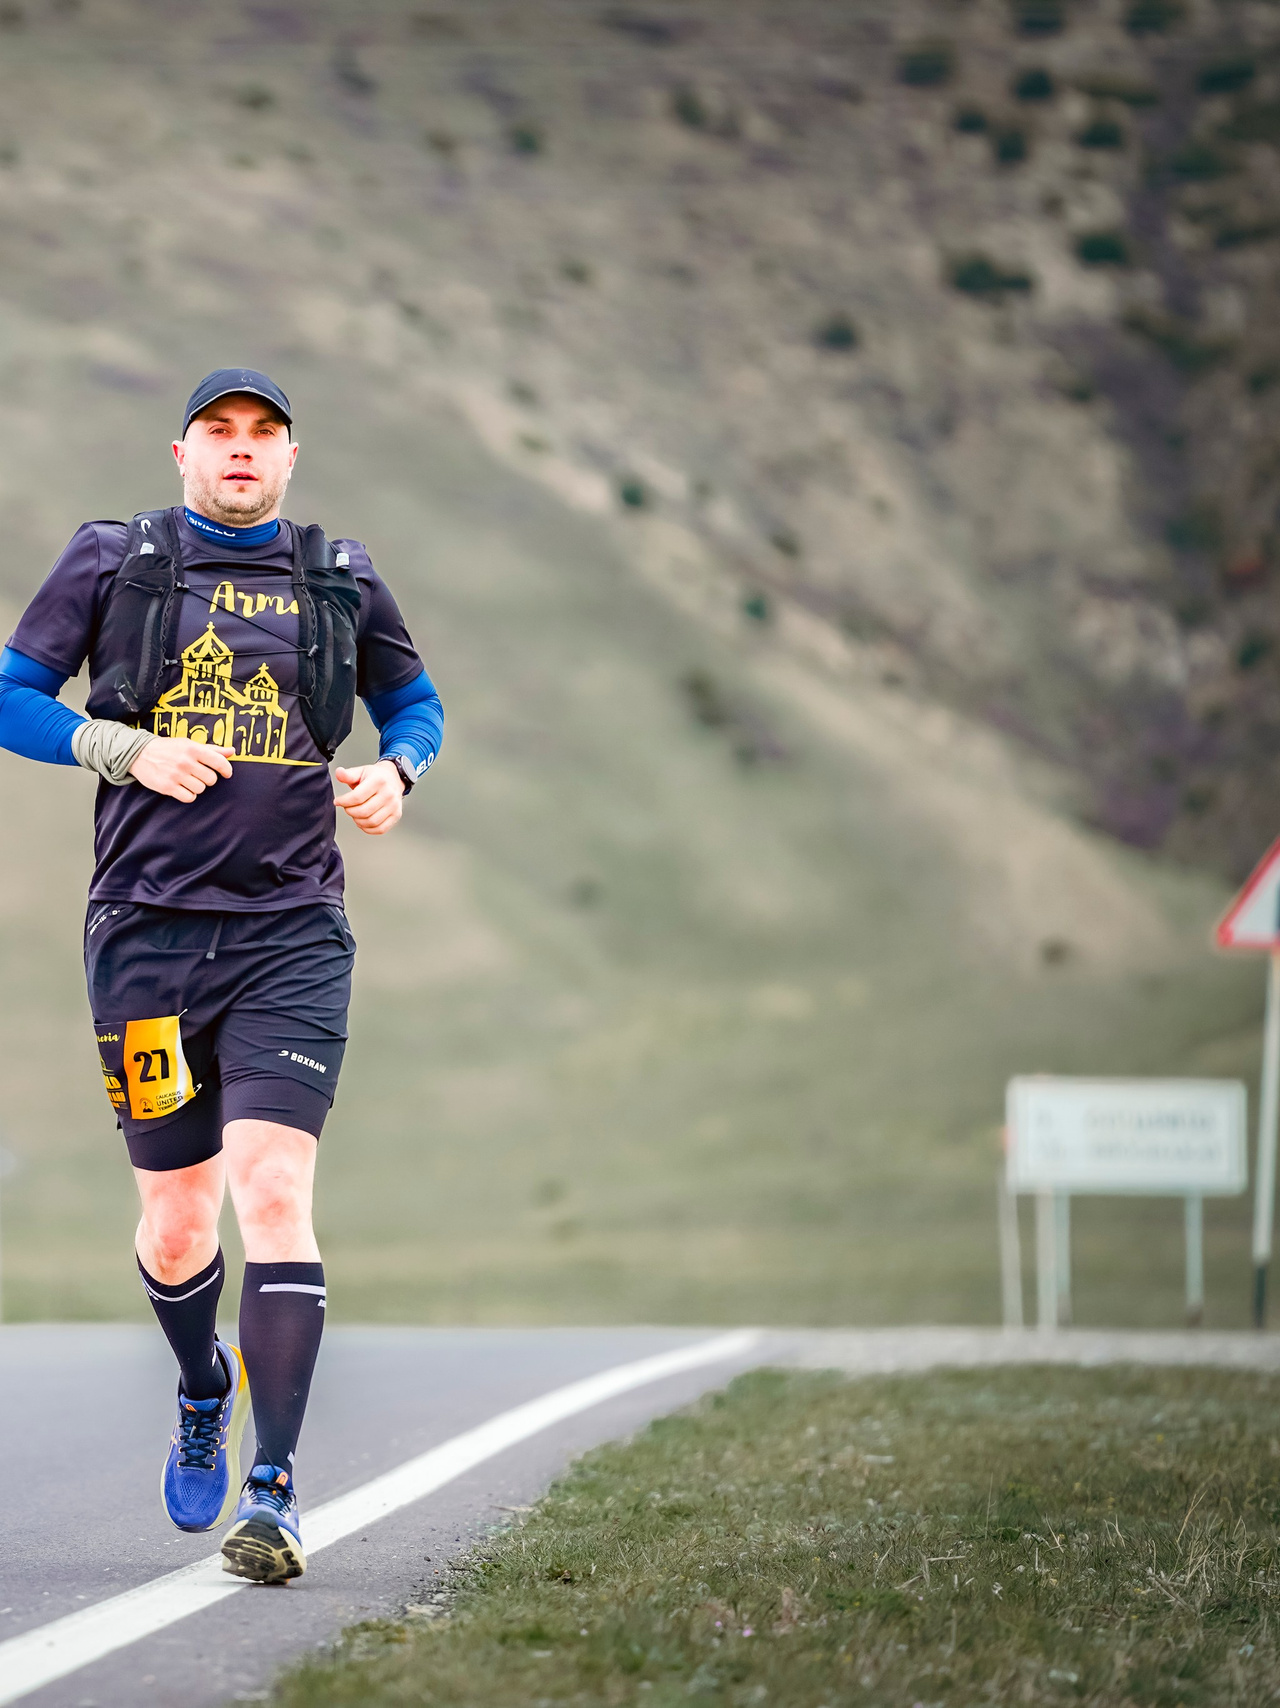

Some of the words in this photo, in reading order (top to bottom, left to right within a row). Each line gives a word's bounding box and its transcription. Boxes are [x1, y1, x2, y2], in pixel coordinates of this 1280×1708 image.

[133, 1048, 170, 1083] 27
[290, 1052, 327, 1074] BOXRAW
[155, 1090, 182, 1100] CAUCASUS
[156, 1095, 184, 1107] UNITED
